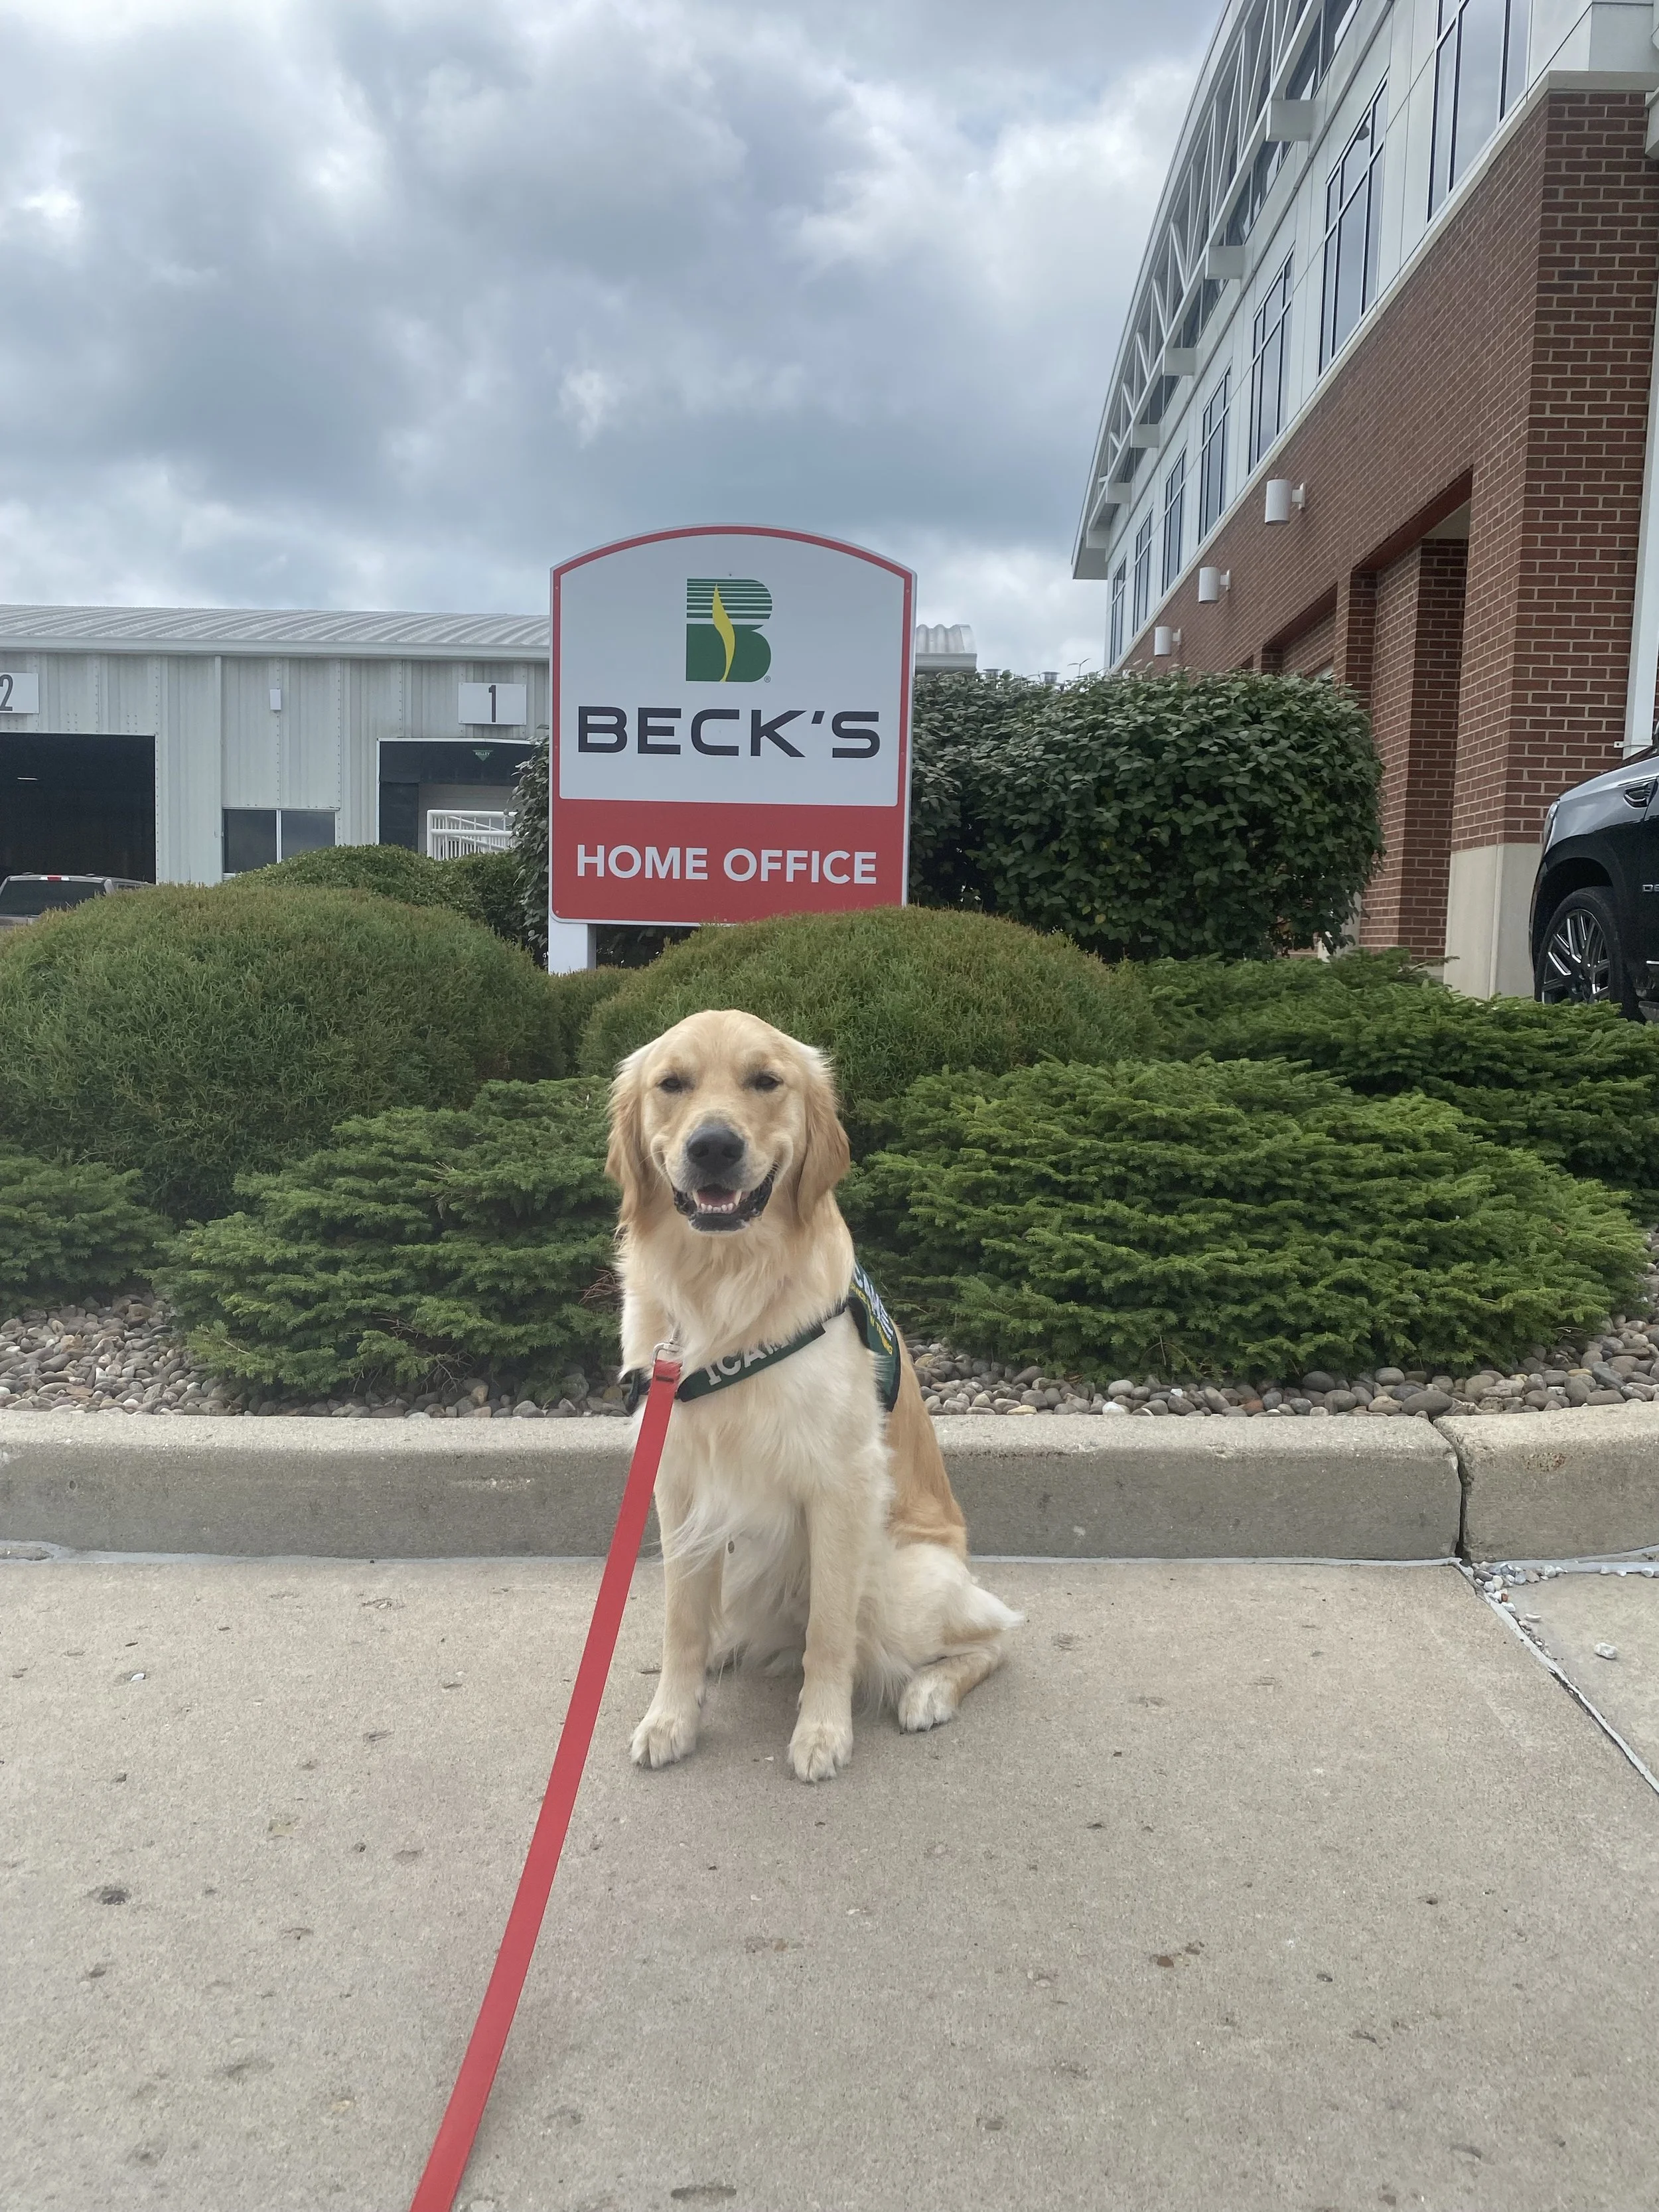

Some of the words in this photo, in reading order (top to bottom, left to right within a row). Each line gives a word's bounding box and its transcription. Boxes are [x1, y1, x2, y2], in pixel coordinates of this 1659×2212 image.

[0, 674, 13, 711] 2
[488, 685, 496, 723] 1
[578, 705, 881, 758] BECK'S
[577, 844, 708, 880] HOME
[723, 848, 877, 884] OFFICE
